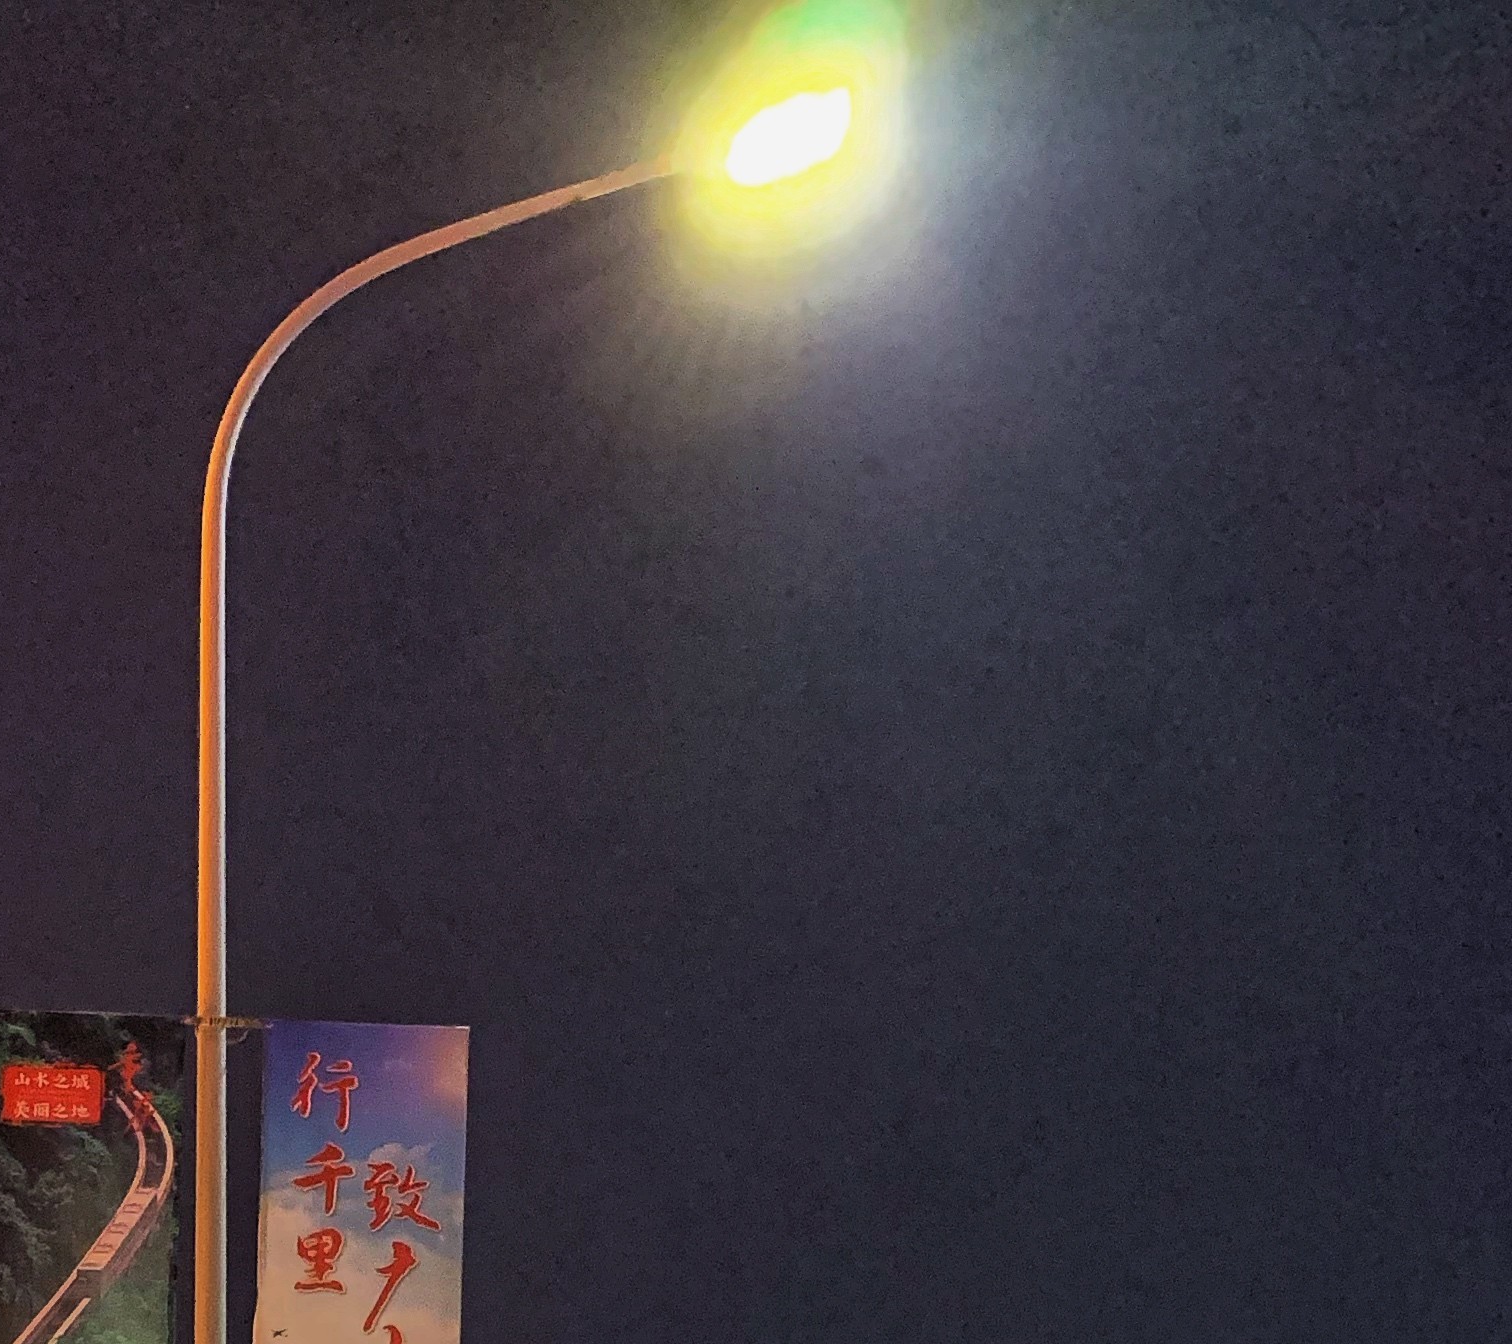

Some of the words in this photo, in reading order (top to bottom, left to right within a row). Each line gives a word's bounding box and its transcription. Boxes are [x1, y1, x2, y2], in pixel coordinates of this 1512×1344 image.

[14, 1072, 90, 1090] 山水之城
[14, 1101, 90, 1119] 美丽之地
[291, 1052, 357, 1293] 行千里
